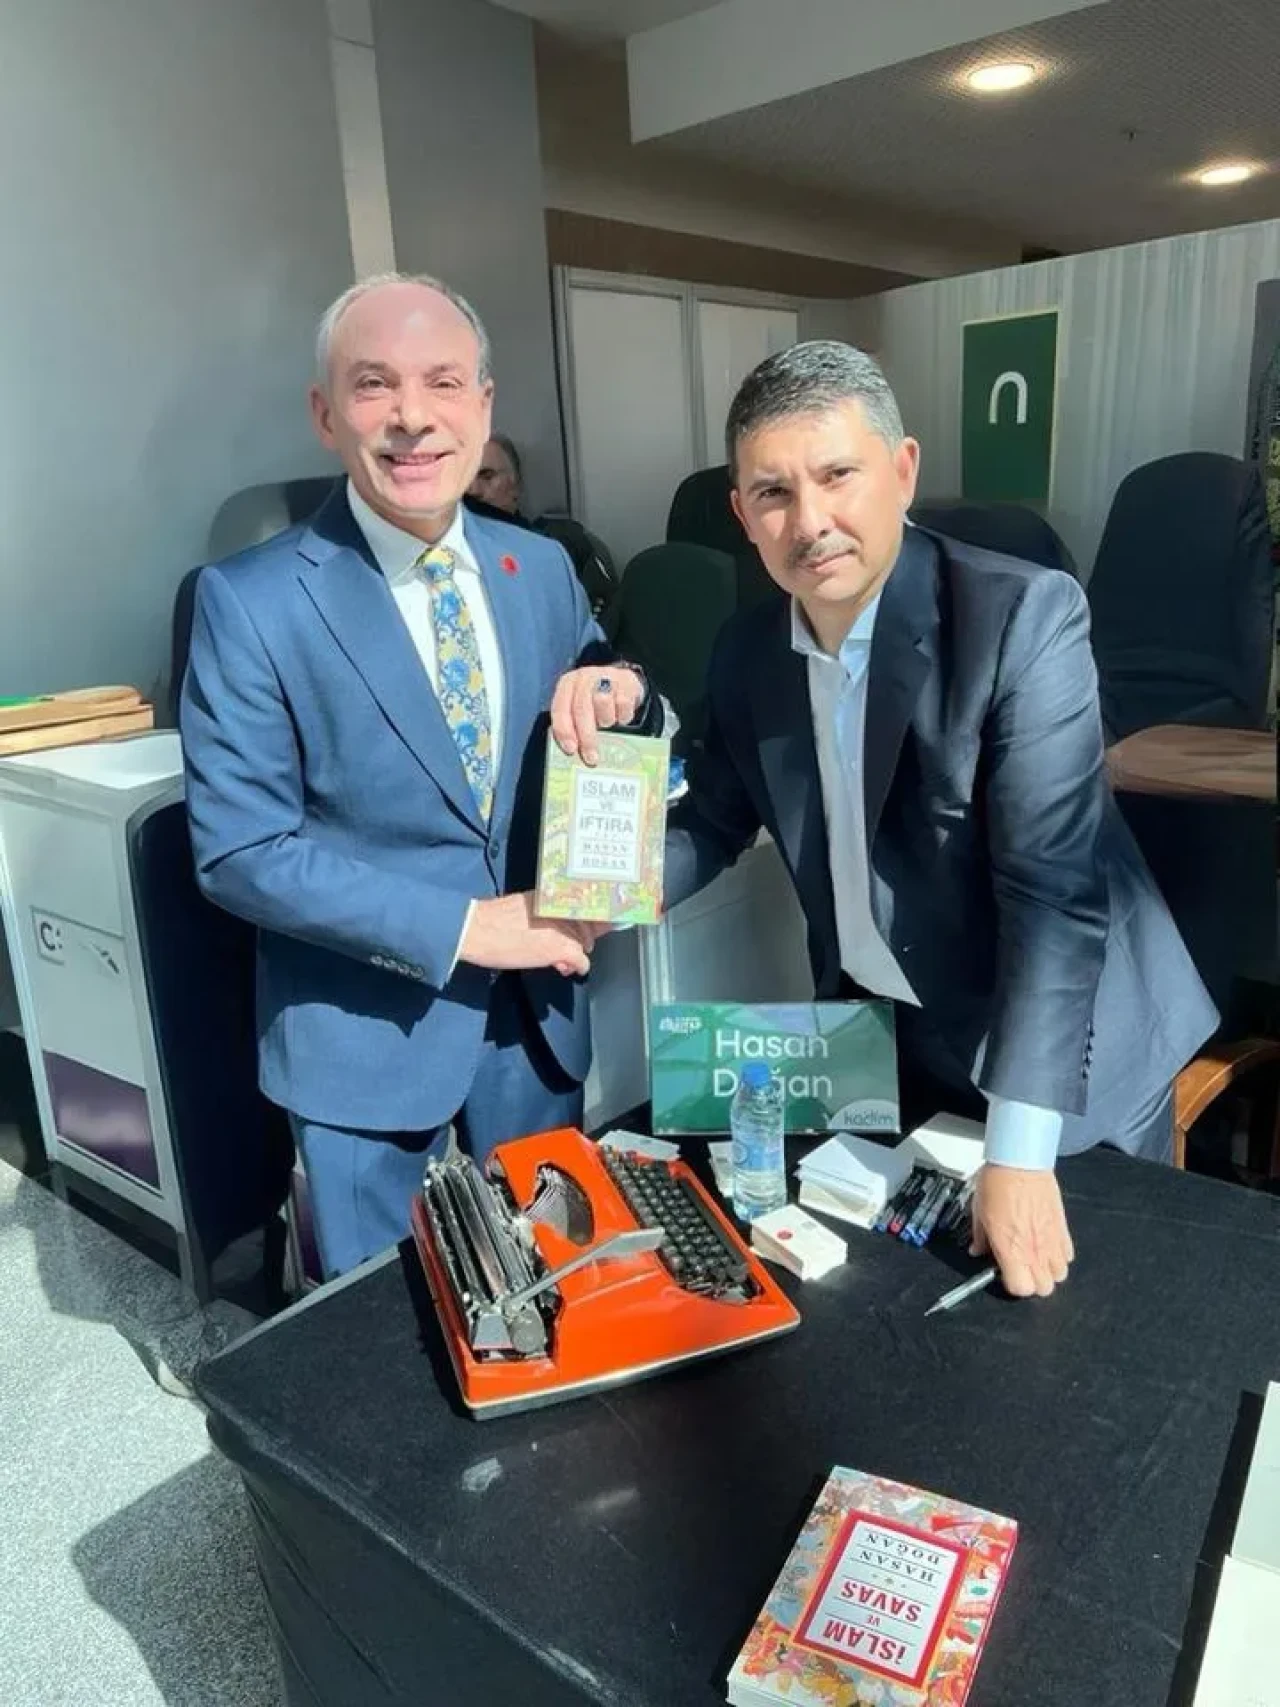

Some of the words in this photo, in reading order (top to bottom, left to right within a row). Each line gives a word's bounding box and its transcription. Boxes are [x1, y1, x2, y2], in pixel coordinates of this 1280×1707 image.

[715, 1030, 828, 1059] Hasan
[713, 1067, 833, 1098] Dğan
[866, 1532, 941, 1566] DOĞAN
[859, 1550, 934, 1583] HASAN
